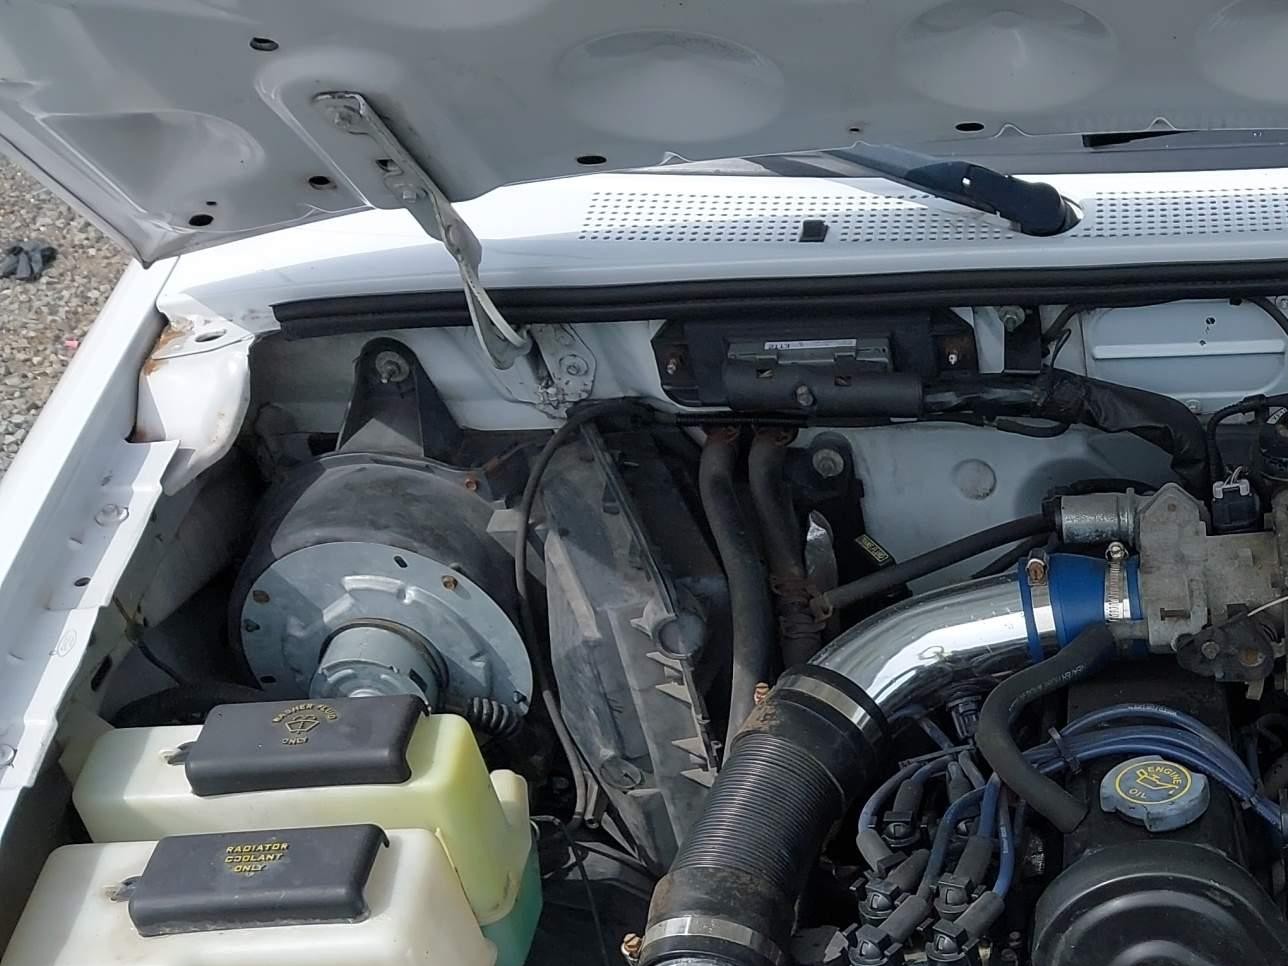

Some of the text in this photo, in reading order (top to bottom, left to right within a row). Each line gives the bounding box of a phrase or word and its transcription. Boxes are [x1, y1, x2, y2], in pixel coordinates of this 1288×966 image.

[281, 736, 309, 745] ONLY
[1147, 766, 1183, 785] ENGINE
[1128, 788, 1148, 799] OIL
[226, 842, 289, 854] RADIATOR
[224, 853, 283, 863] COOLANT
[234, 863, 267, 872] ONLY
